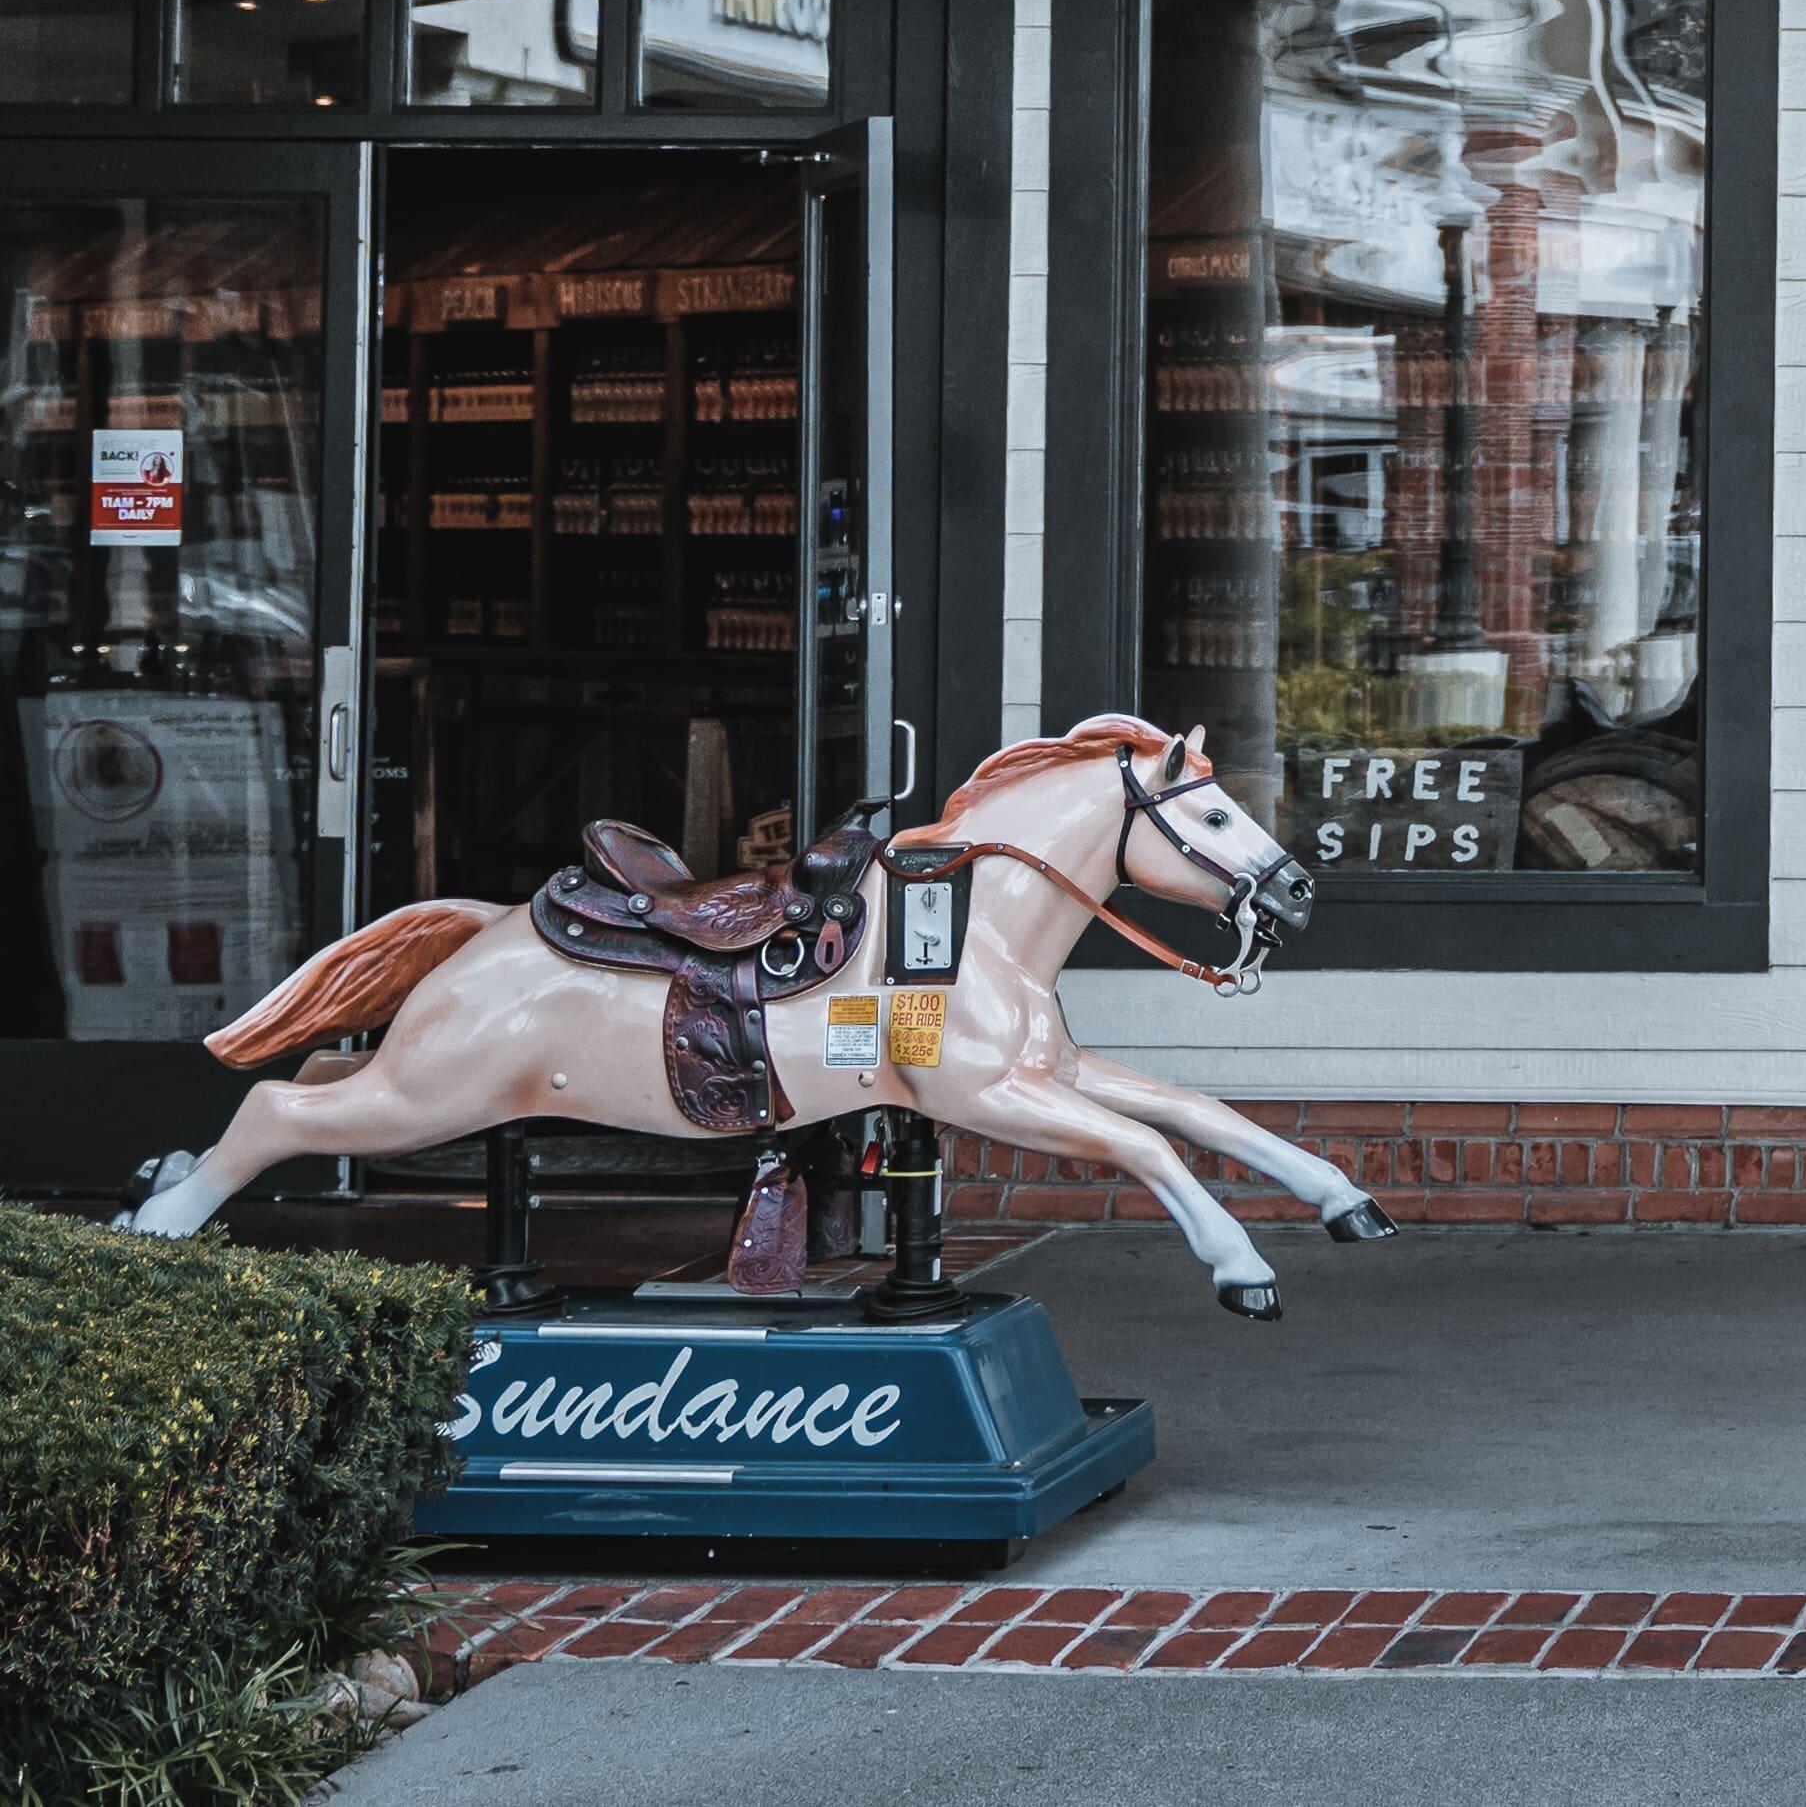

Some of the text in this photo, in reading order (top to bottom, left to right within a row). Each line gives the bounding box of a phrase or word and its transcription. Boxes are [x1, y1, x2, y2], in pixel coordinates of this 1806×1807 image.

[101, 450, 139, 461] BACK!
[145, 496, 174, 508] 7PM
[1322, 757, 1487, 802] FREE
[1316, 821, 1480, 863] SIPS
[896, 993, 940, 1012] $1.00
[892, 1012, 942, 1027] PER RIDE
[435, 1338, 901, 1447] Sundance
